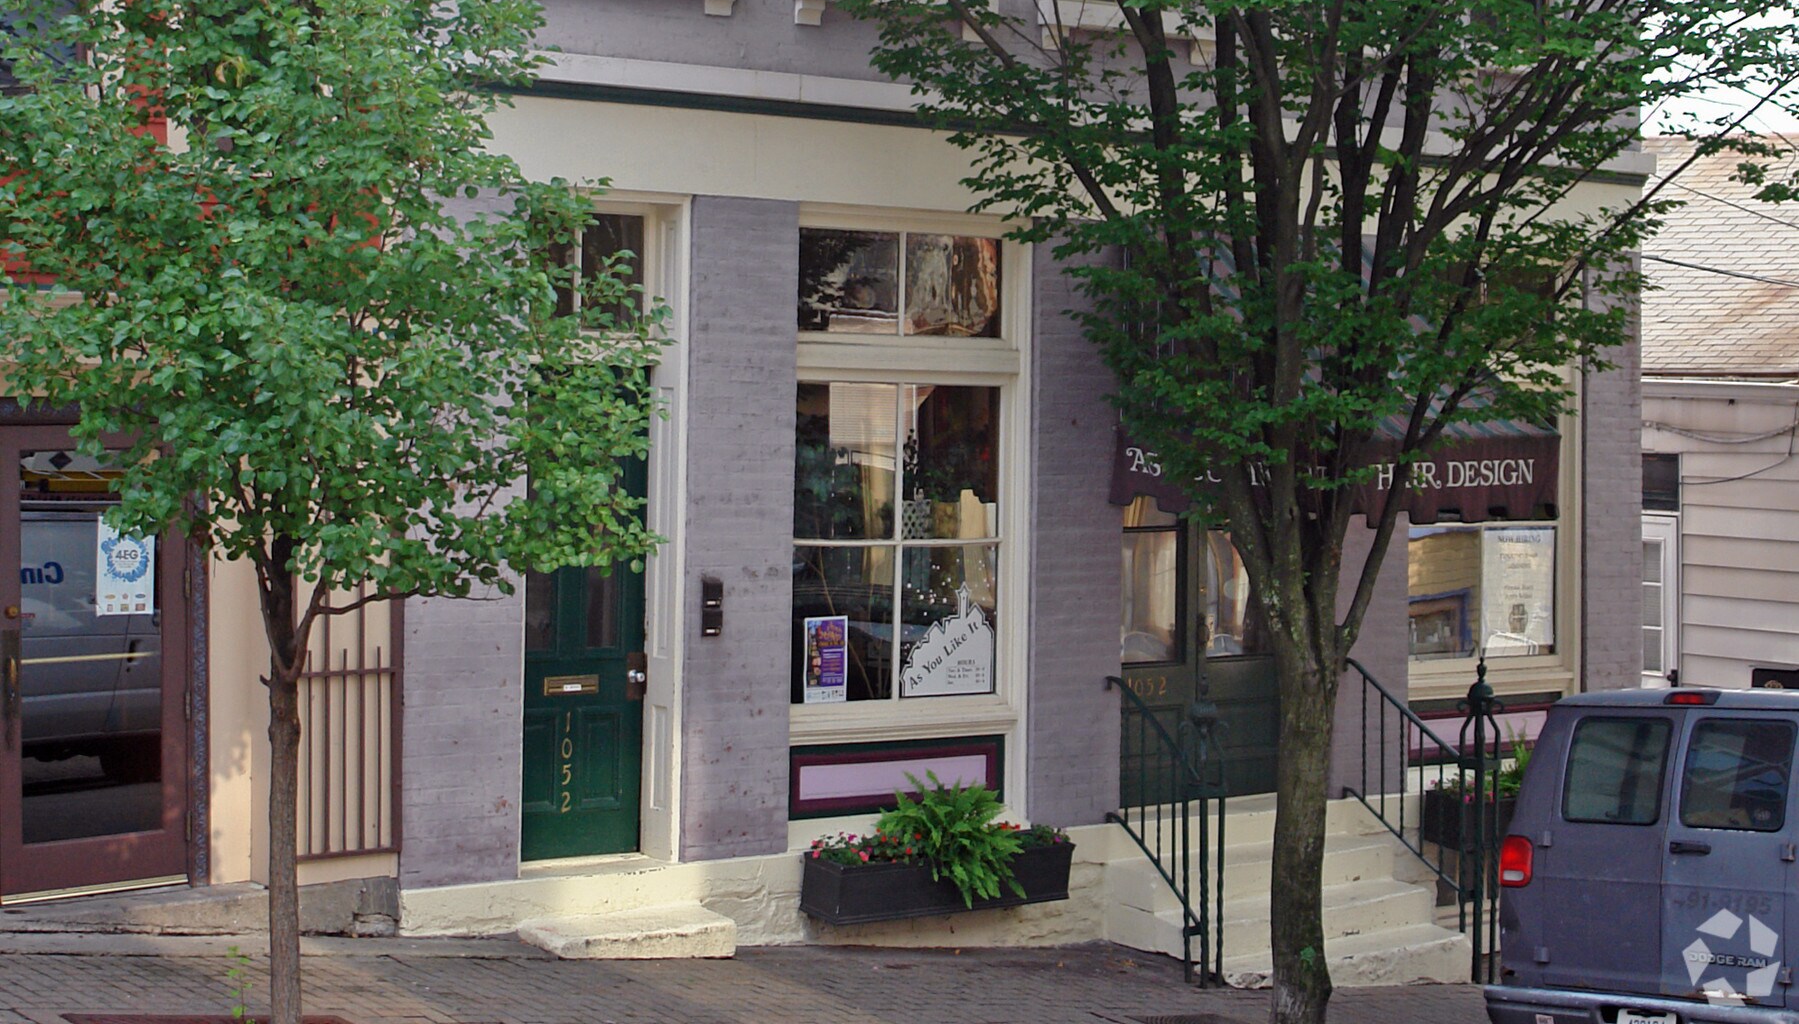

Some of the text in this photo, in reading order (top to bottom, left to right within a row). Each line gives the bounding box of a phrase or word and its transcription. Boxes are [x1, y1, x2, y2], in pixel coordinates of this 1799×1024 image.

[1375, 461, 1442, 490] HIR
[1446, 459, 1535, 488] DESIGN
[909, 621, 979, 690] As You Like It
[561, 711, 573, 813] 1052
[1689, 952, 1767, 968] DODGE RAM
